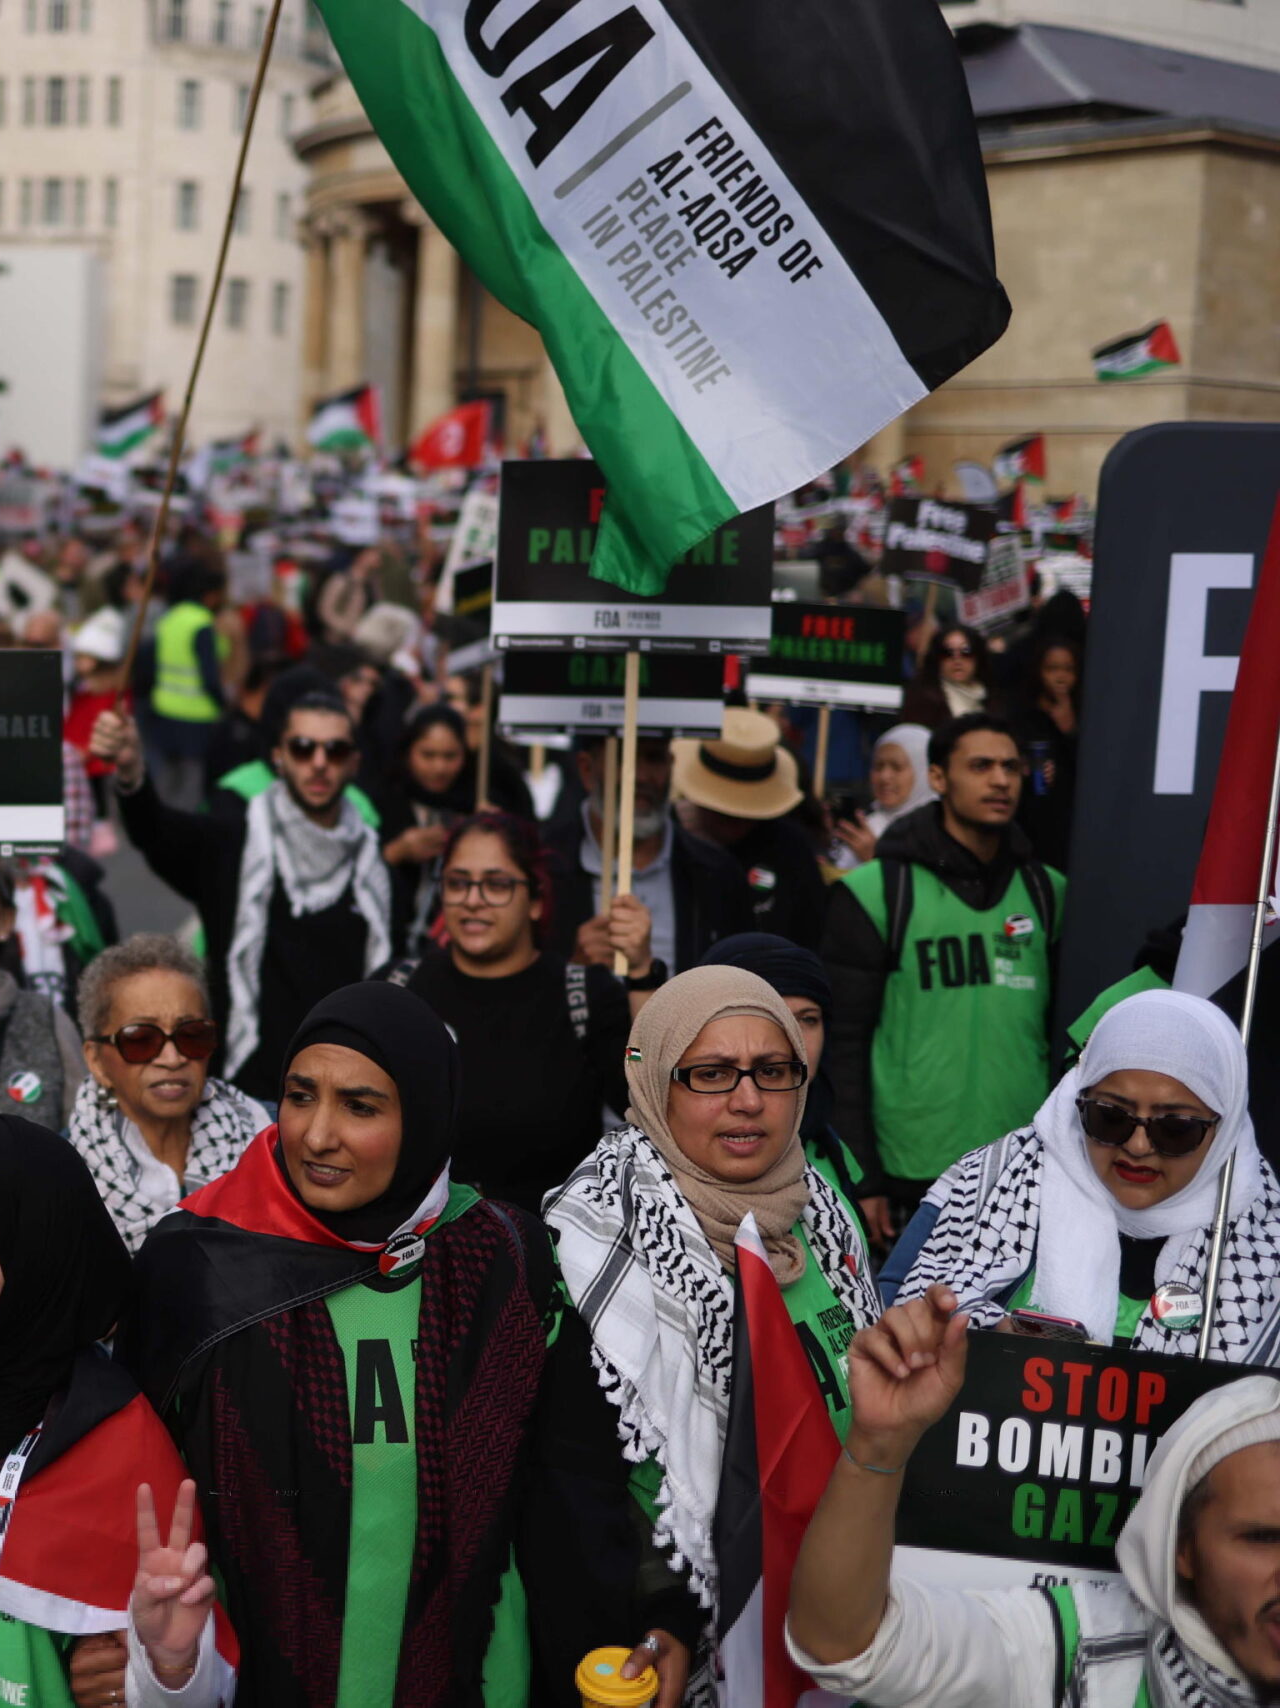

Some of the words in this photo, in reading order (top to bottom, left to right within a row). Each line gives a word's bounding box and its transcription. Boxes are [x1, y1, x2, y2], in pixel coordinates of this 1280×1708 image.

[616, 177, 698, 277] PEACE
[646, 150, 758, 280] AL-AQSA
[684, 117, 795, 247] FRIENDS
[777, 239, 824, 284] OF
[581, 204, 620, 250] IN
[607, 237, 732, 395] PALESTINE
[594, 610, 620, 629] FOA
[802, 614, 855, 641] FREE
[915, 933, 991, 990] FOA
[401, 1249, 415, 1261] FOA
[1175, 1300, 1190, 1311] FOA
[1022, 1357, 1166, 1424] STOP
[1012, 1483, 1141, 1547] GAZ
